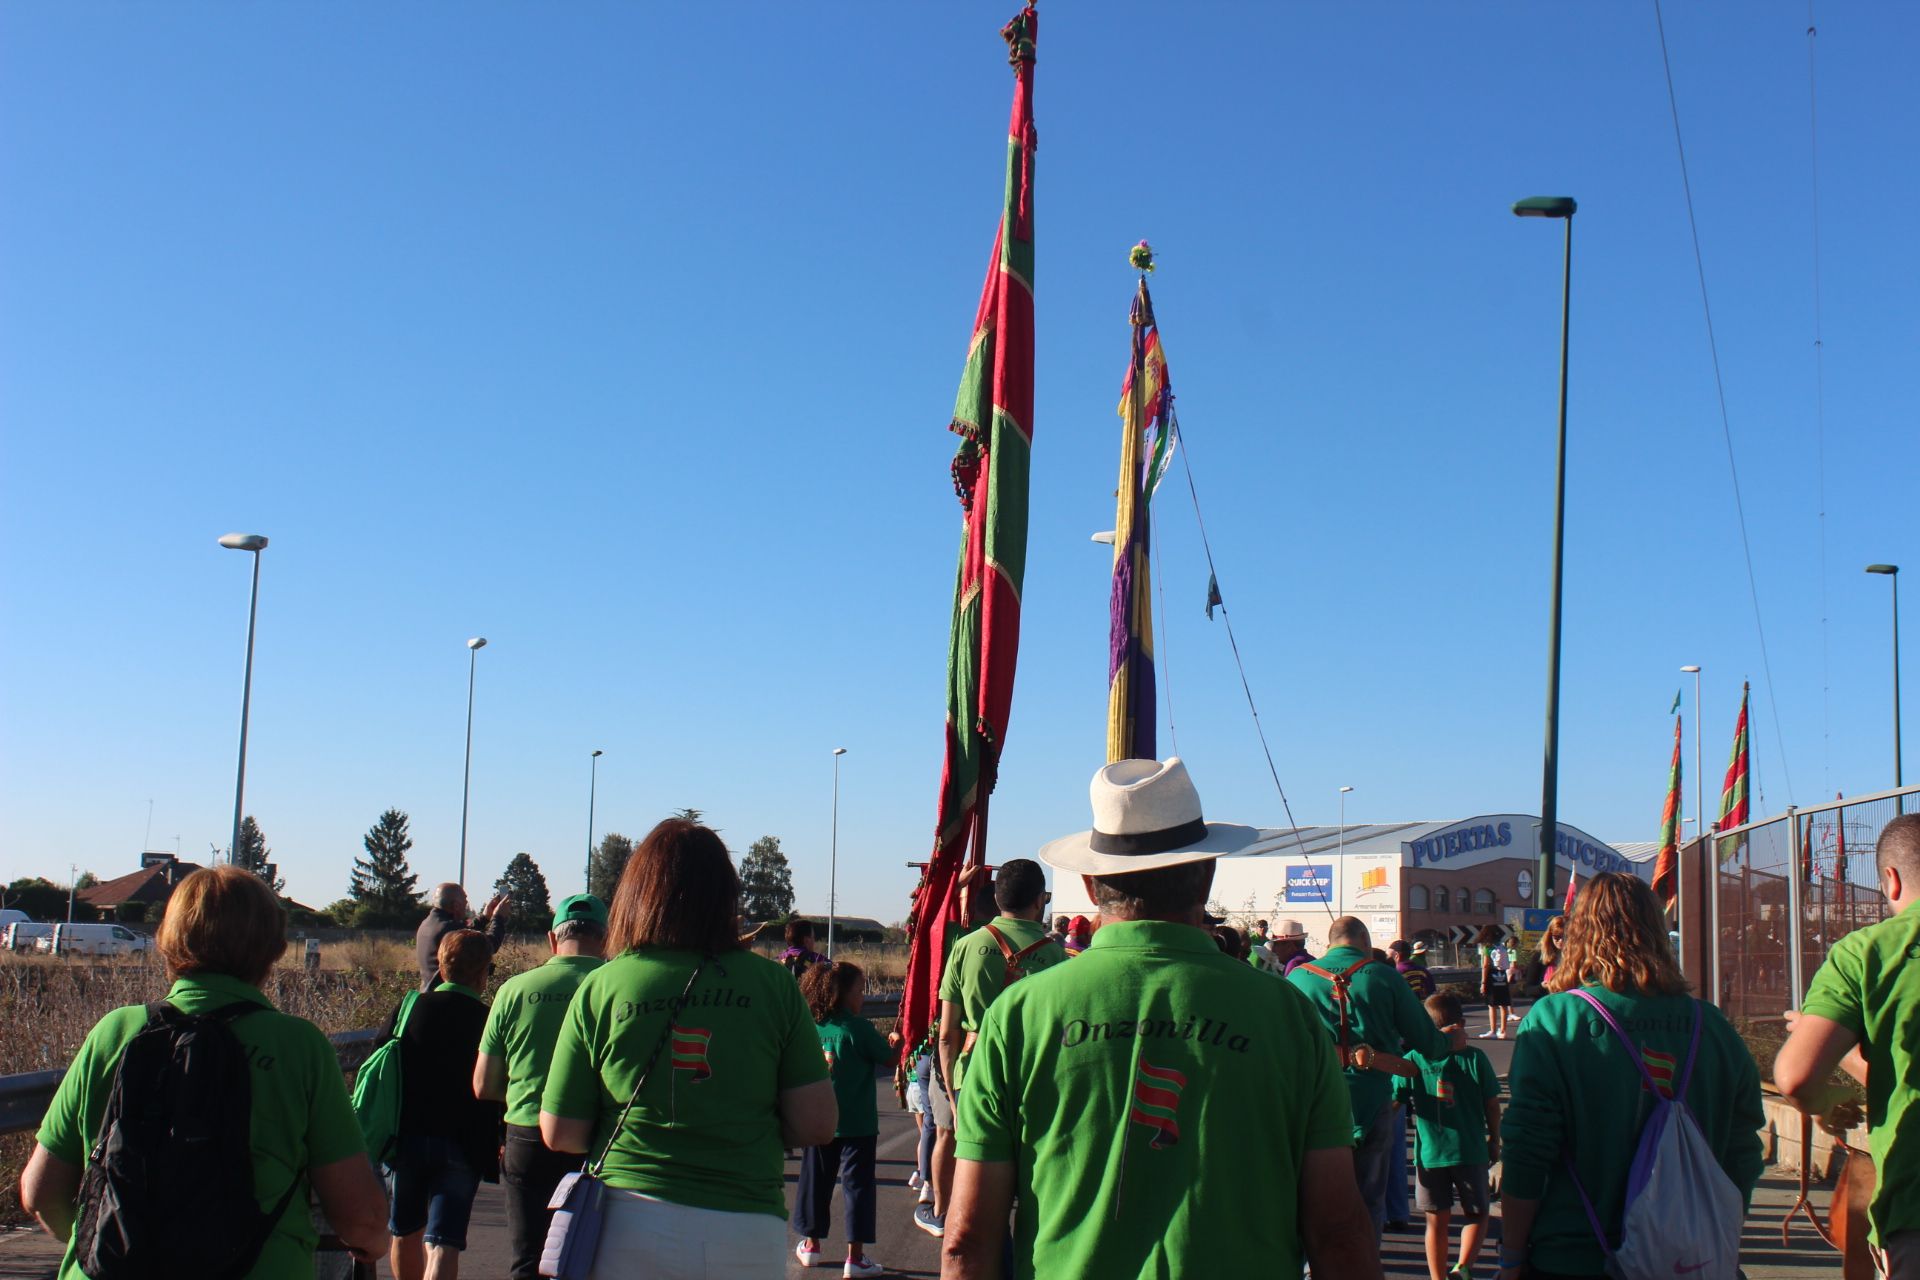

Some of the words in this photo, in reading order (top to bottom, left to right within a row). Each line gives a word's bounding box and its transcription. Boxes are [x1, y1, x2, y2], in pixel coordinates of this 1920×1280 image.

[1410, 822, 1512, 867] PUERTAS
[1540, 830, 1633, 873] RUCERO
[1287, 878, 1311, 887] QUICK
[616, 988, 751, 1023] Onzonilla
[1061, 1015, 1250, 1053] Onzonilla
